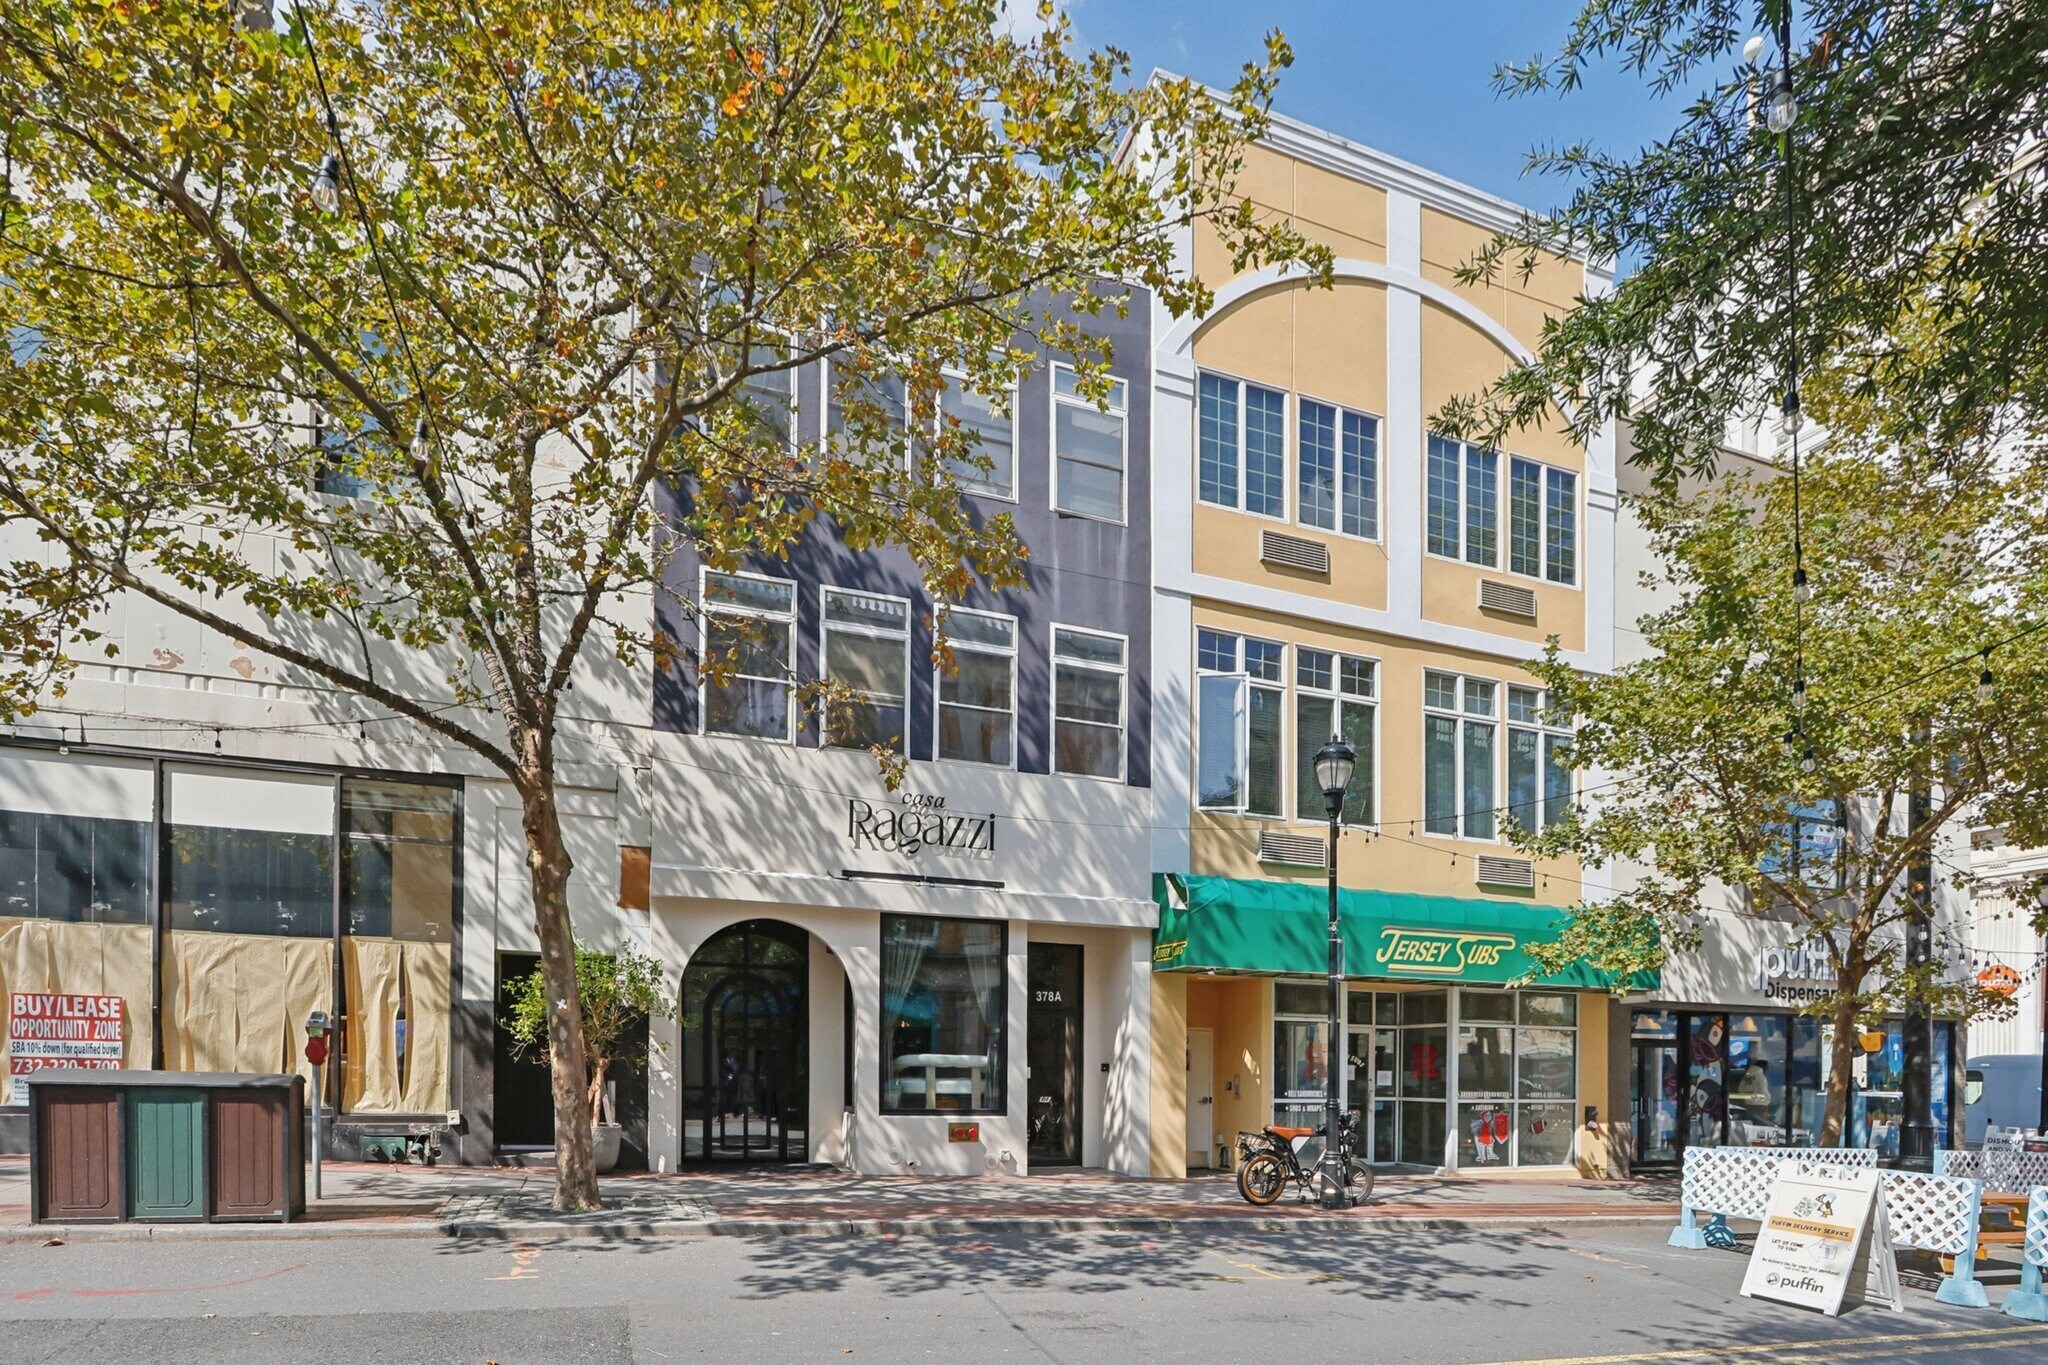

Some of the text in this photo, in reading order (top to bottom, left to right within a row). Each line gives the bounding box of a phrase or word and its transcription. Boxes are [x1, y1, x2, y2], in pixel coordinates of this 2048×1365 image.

[902, 792, 945, 808] casa
[848, 799, 995, 854] Ragazzi
[1376, 929, 1516, 971] JERSEY SUBS
[1036, 990, 1062, 1002] 378A
[1765, 982, 1839, 1003] Dispensar
[13, 994, 121, 1018] BUY/LEASE
[12, 1018, 121, 1040] OPPORTUNITY ZONE
[12, 1041, 121, 1058] SBA 10% down (for qualified buyer)
[1793, 1223, 1821, 1232] DELIVERY
[1824, 1228, 1850, 1237] SERVICE
[1780, 1277, 1824, 1293] puffin
